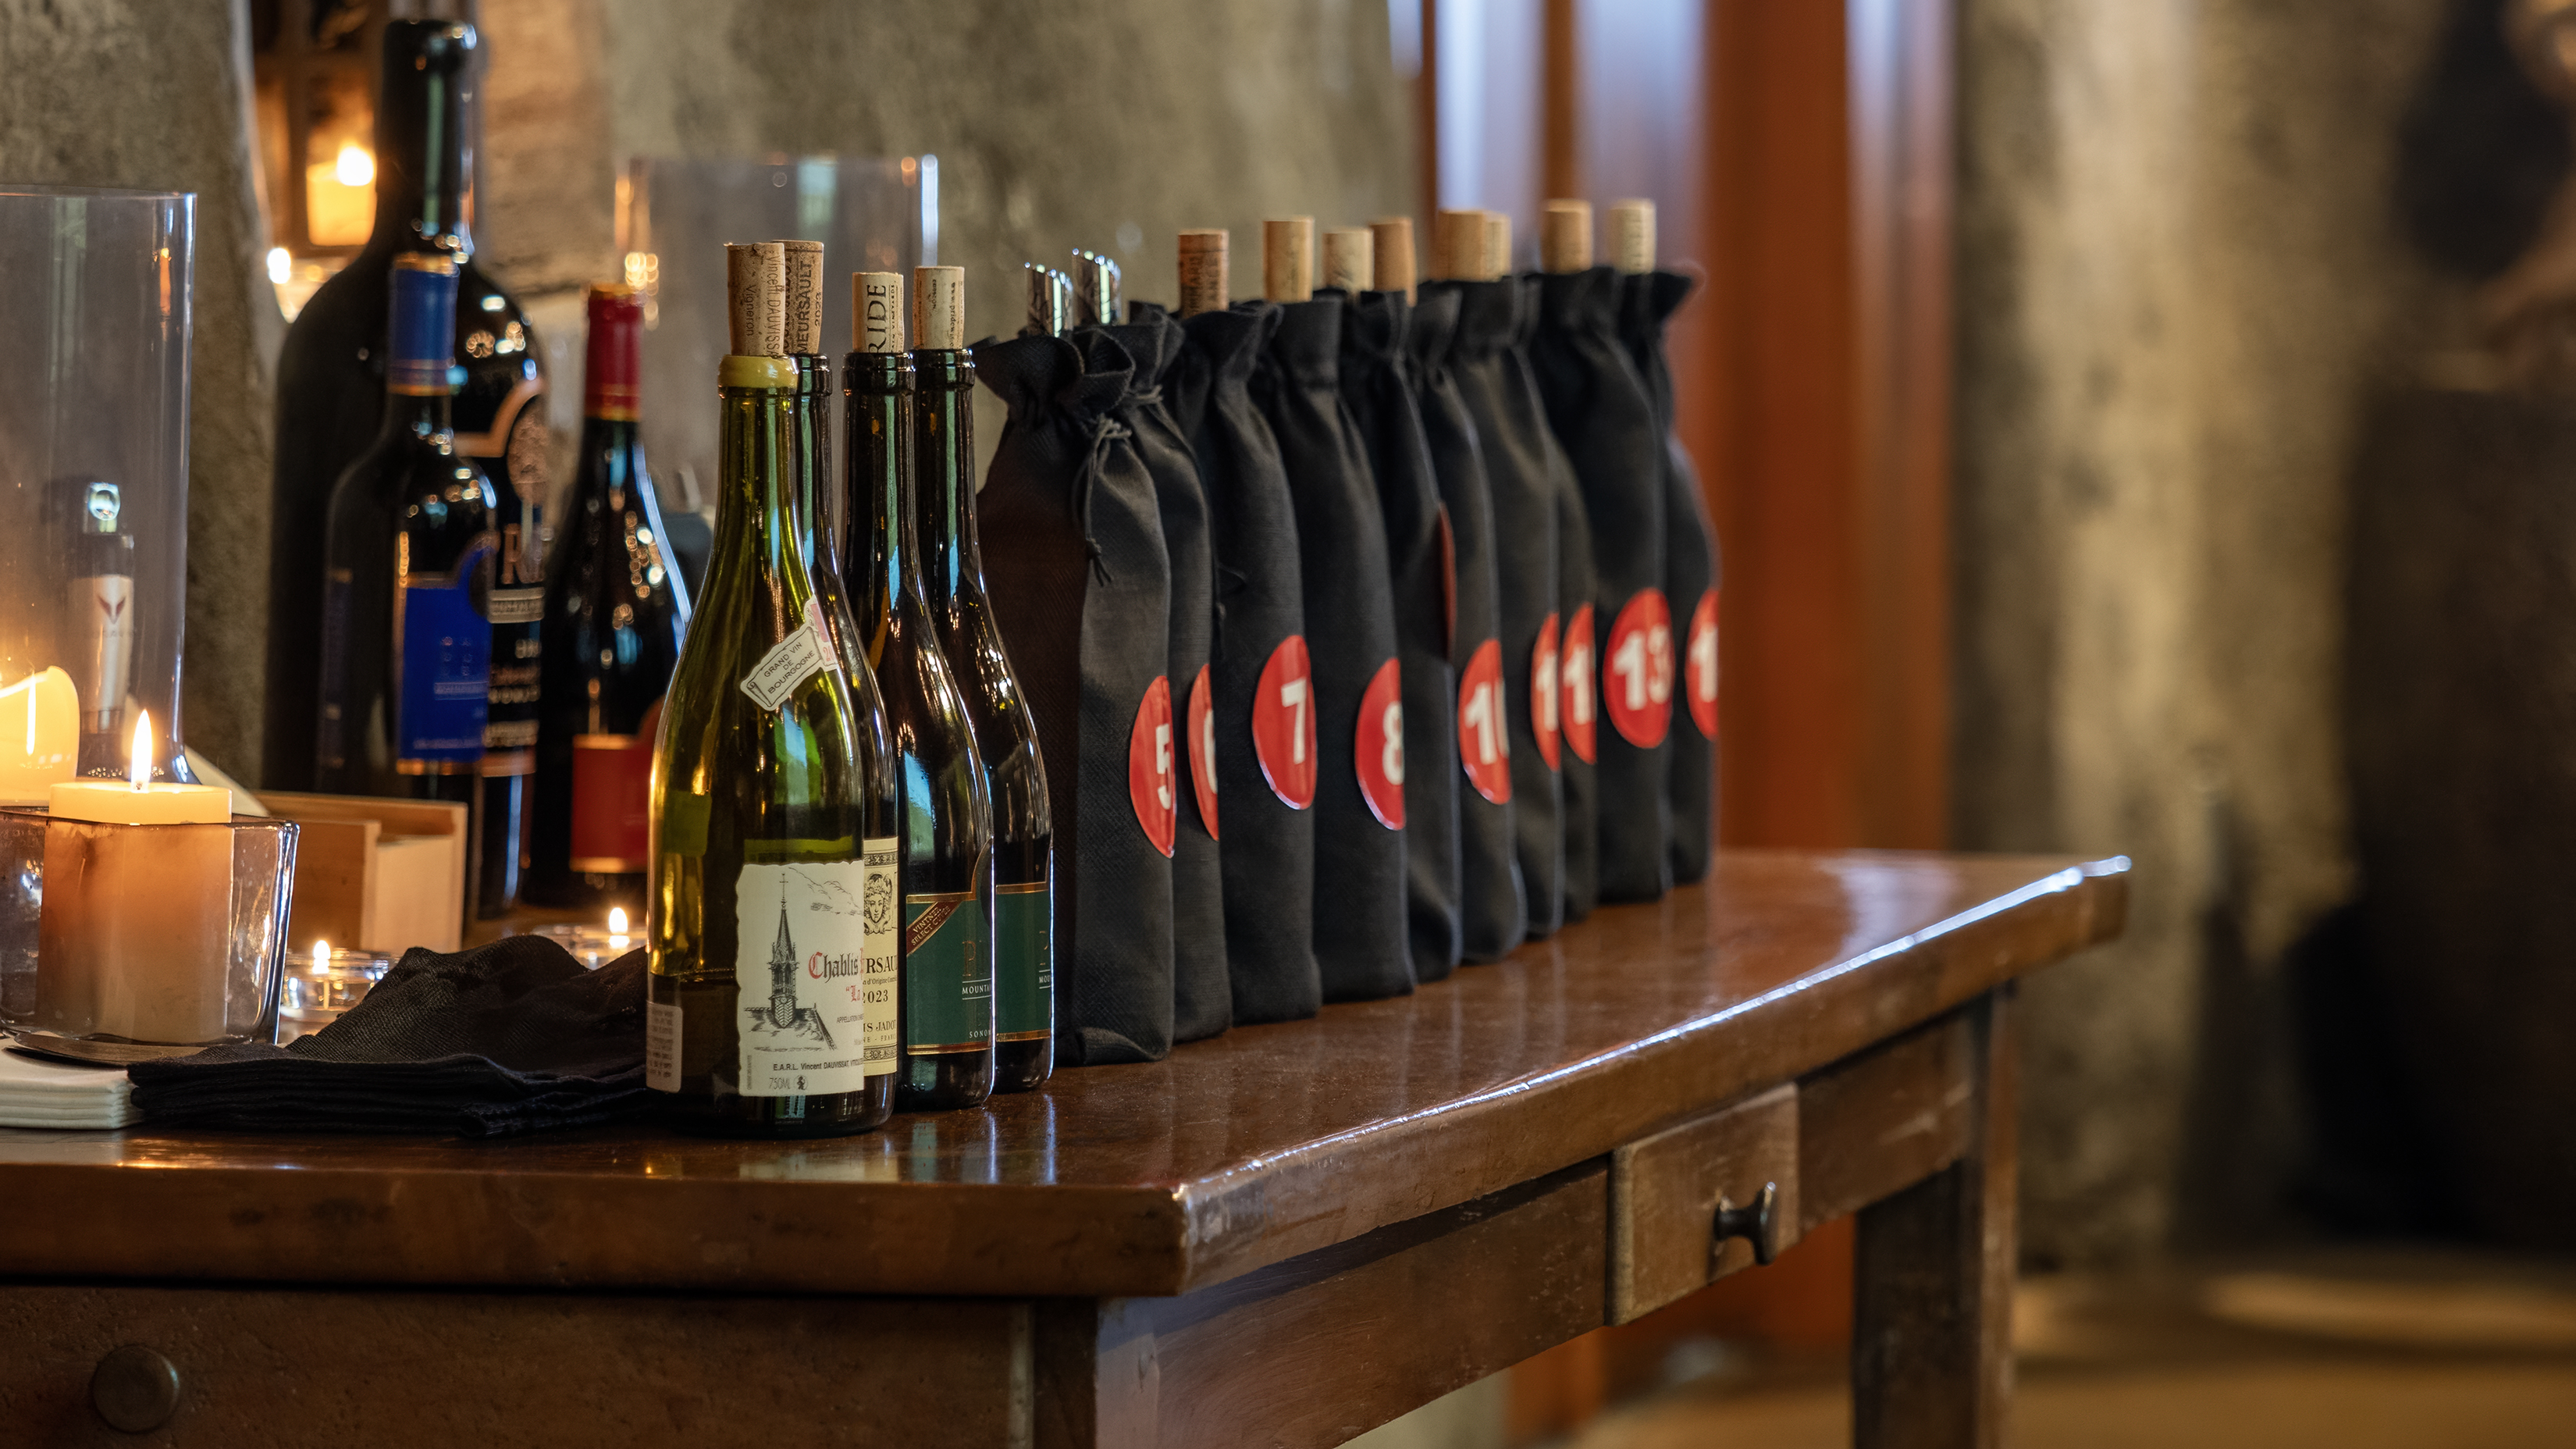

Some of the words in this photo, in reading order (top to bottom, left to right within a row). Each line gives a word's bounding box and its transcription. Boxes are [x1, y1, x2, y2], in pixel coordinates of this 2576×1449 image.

[744, 284, 756, 336] Vigneron
[797, 261, 813, 353] MEURSAULT
[763, 653, 790, 678] GRAND
[789, 642, 803, 654] VIN
[767, 650, 815, 694] BOURGOGNE
[782, 660, 794, 671] DE
[1614, 623, 1670, 710] 13
[1281, 678, 1307, 765] 7
[1382, 701, 1404, 785] 8
[1156, 723, 1171, 810] 5
[808, 951, 859, 984] Chablis
